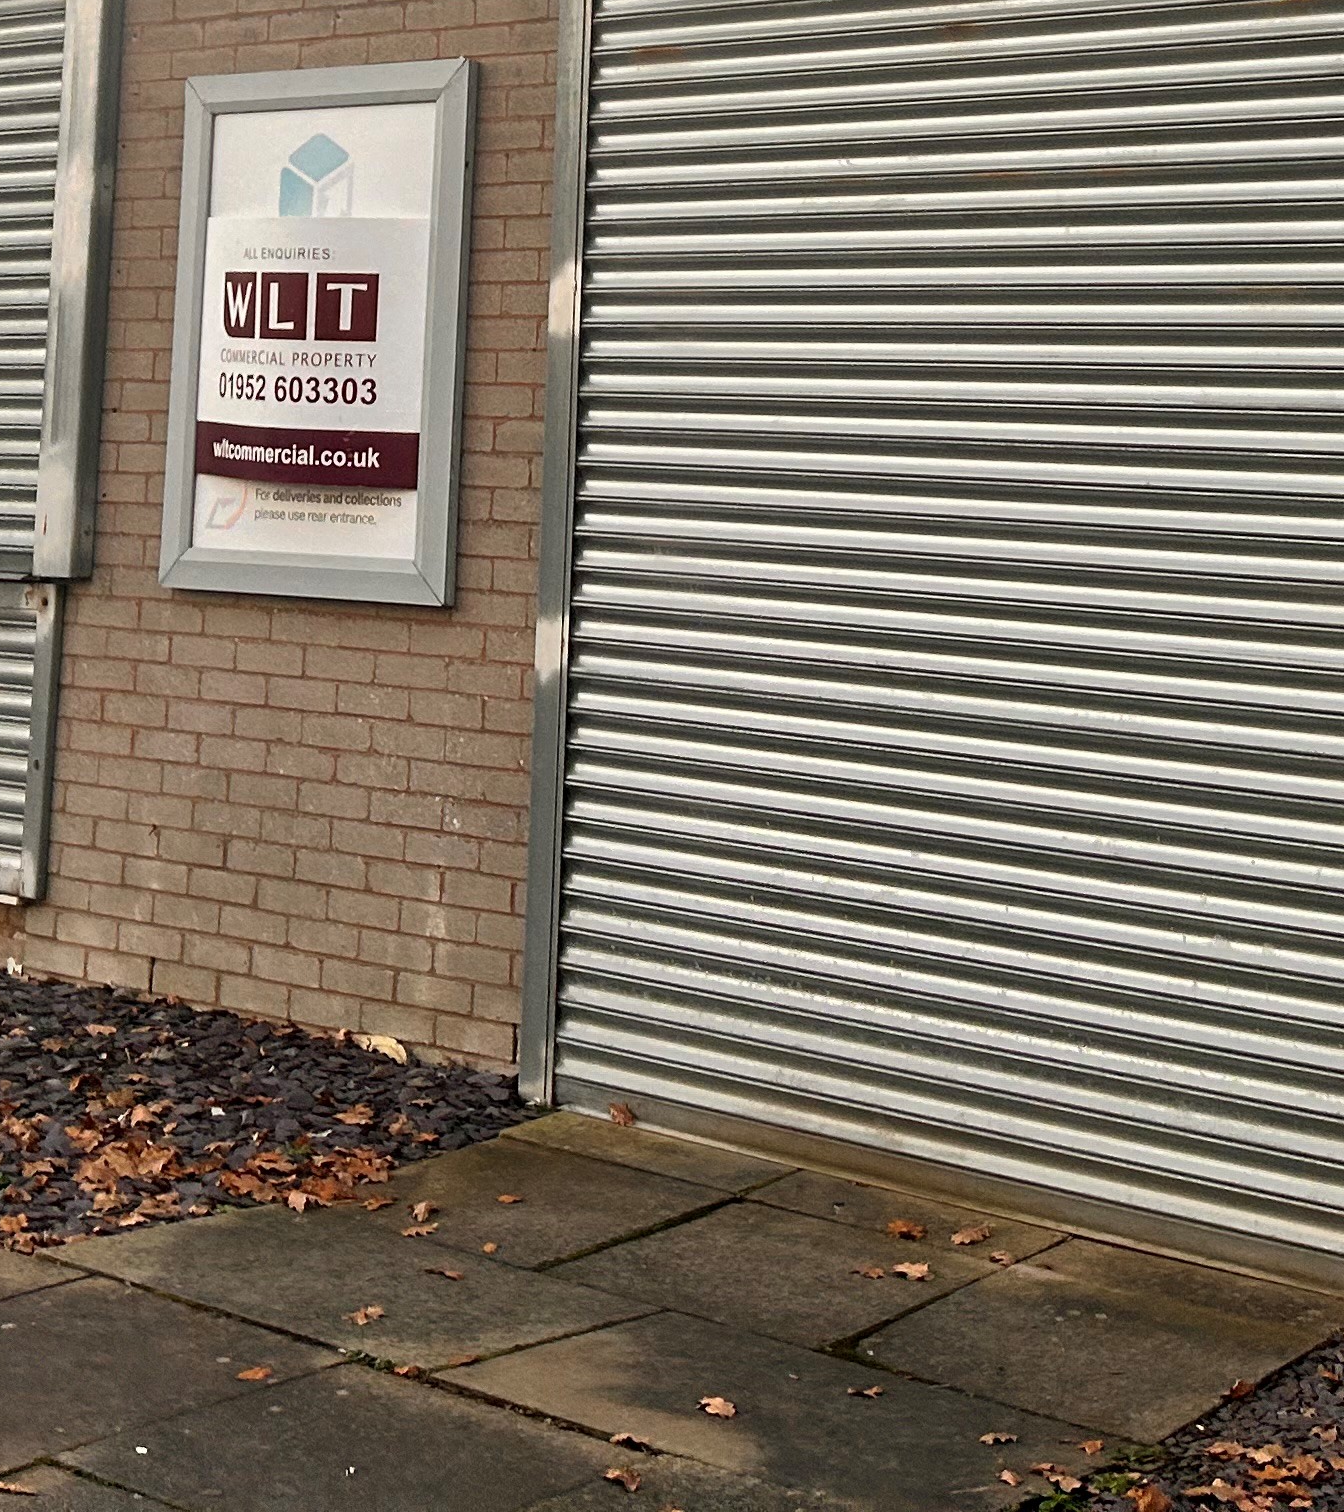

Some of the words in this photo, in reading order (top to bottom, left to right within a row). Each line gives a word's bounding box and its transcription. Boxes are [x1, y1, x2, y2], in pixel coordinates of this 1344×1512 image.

[243, 247, 258, 260] ALL
[220, 348, 285, 366] COMMERCIAL
[292, 352, 377, 368] PROPERTY
[219, 372, 266, 401] 01952
[274, 375, 377, 405] 603303
[213, 438, 380, 468] wltcommercial.co.uk
[255, 488, 270, 500] For
[272, 489, 321, 504] deliveries
[323, 492, 343, 505] and
[344, 493, 402, 507] collections
[255, 509, 285, 521] please
[288, 511, 305, 522] use
[307, 512, 326, 523] rear
